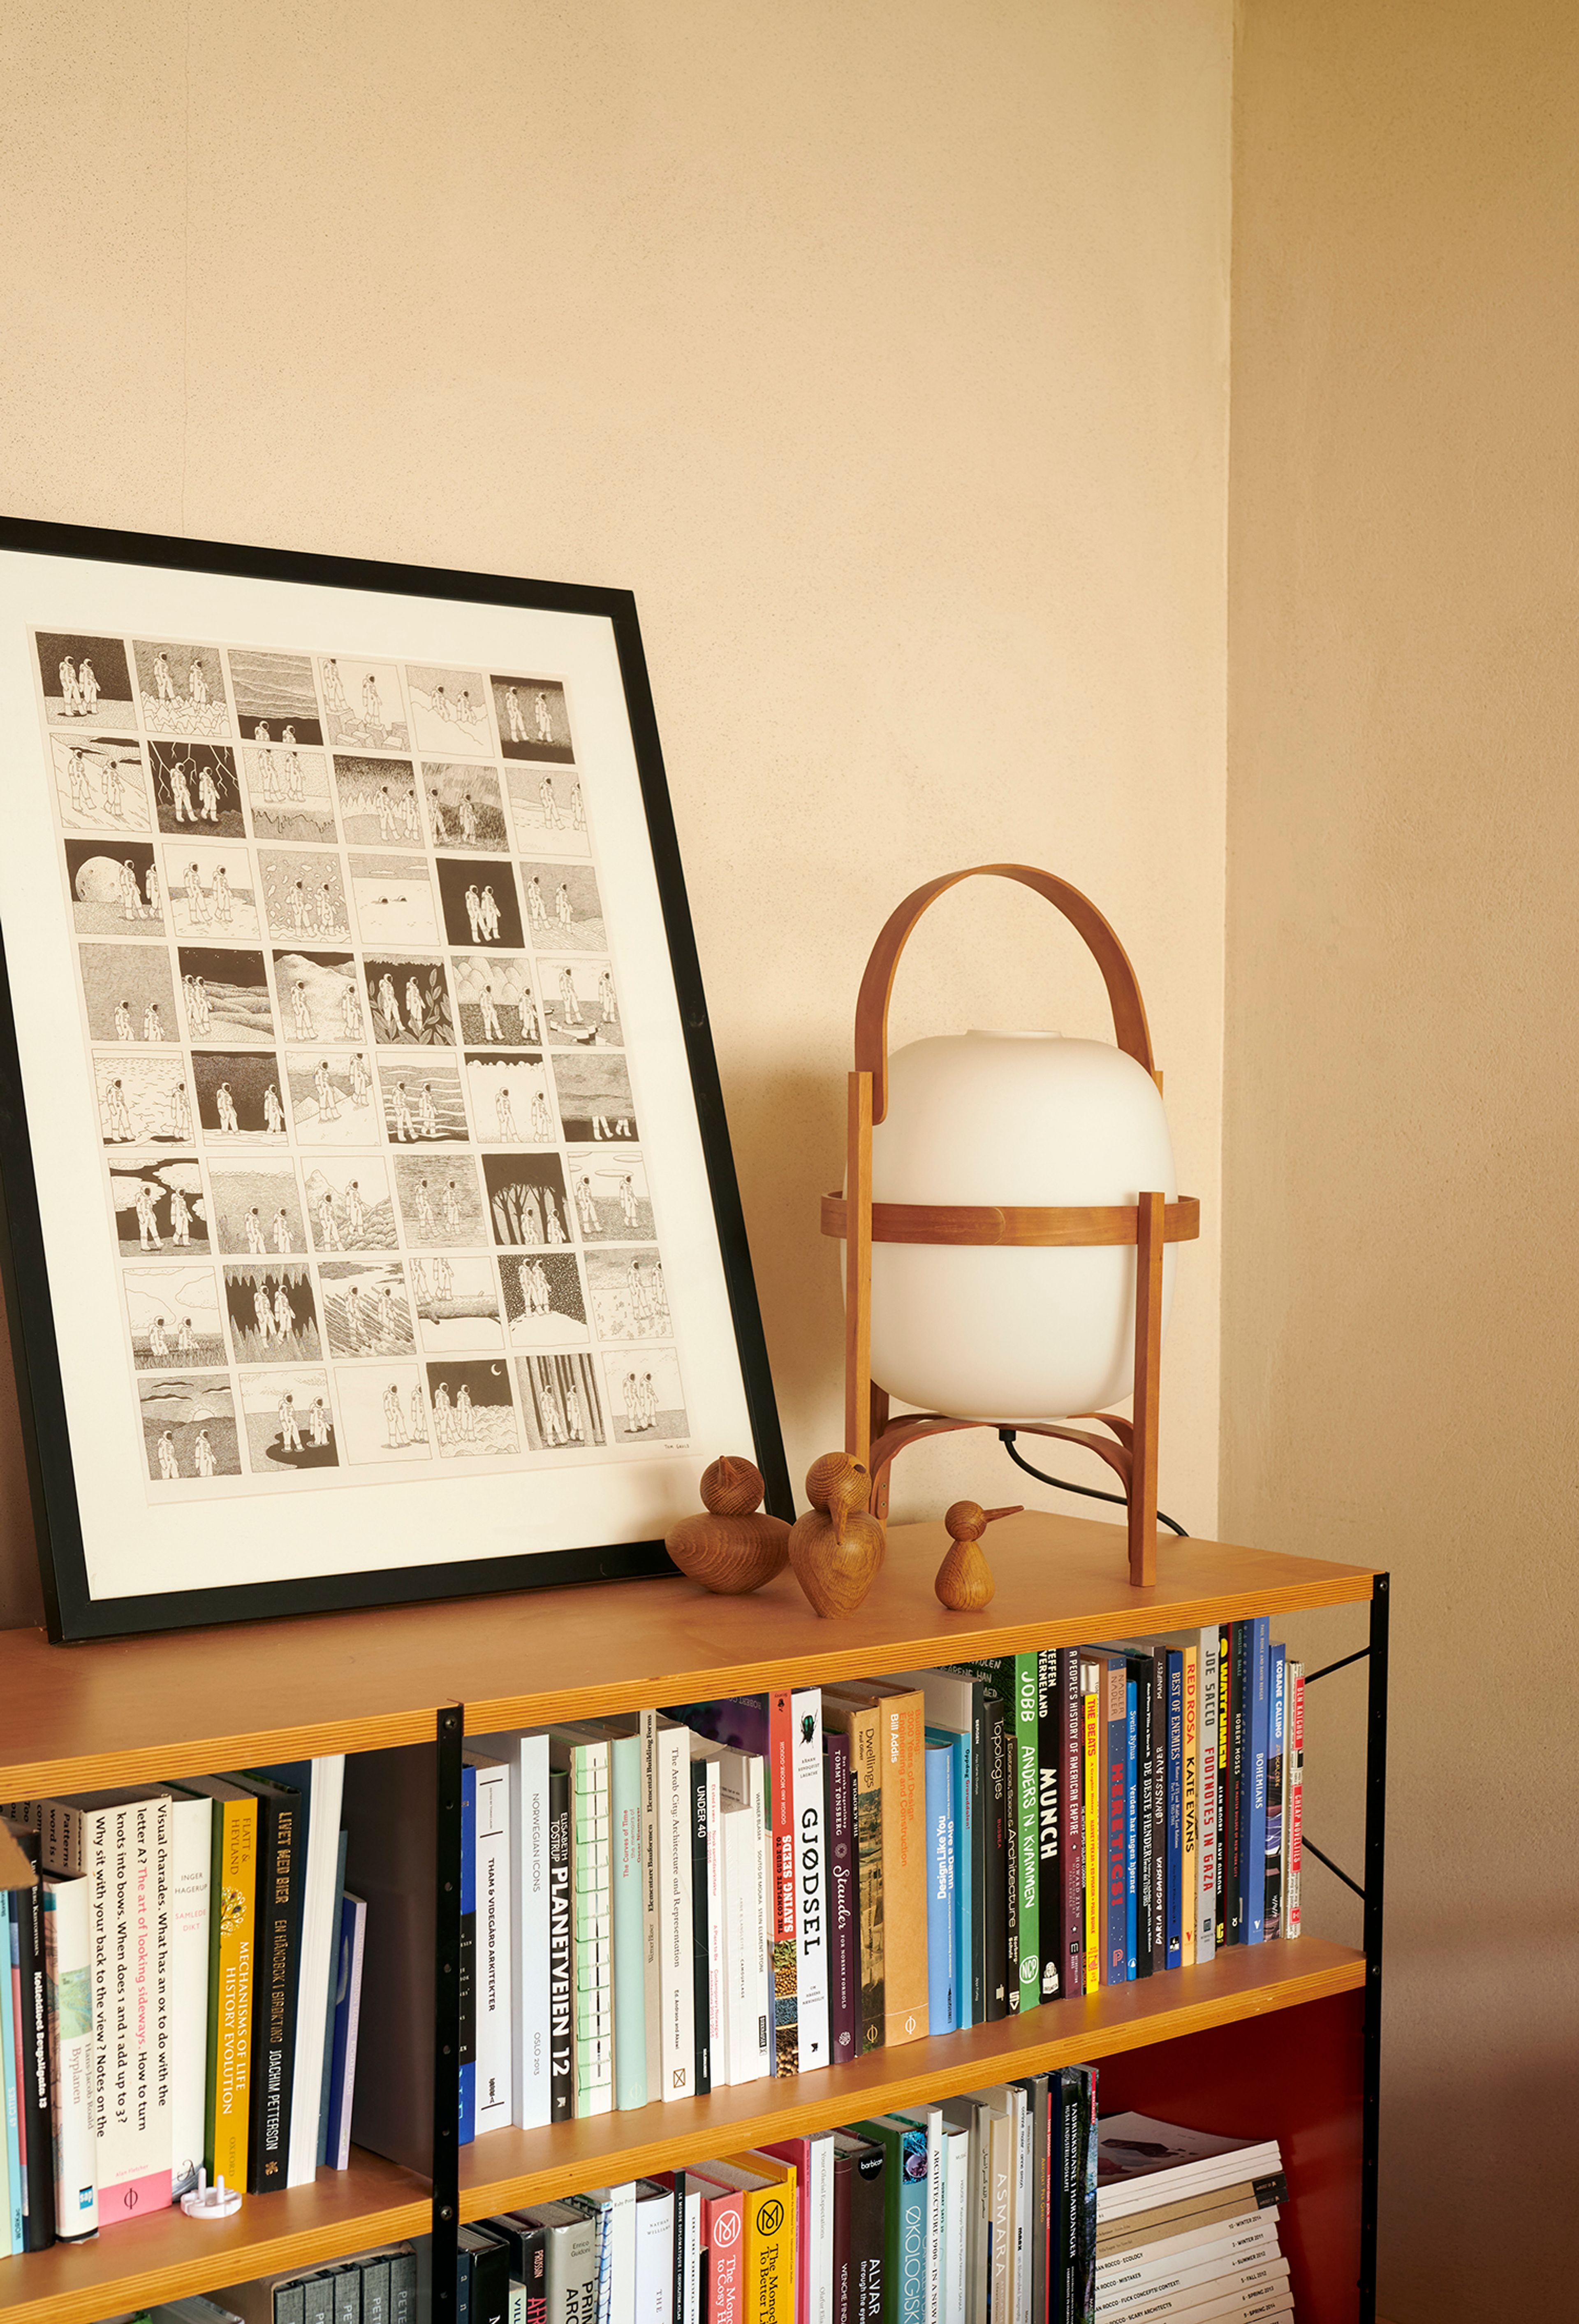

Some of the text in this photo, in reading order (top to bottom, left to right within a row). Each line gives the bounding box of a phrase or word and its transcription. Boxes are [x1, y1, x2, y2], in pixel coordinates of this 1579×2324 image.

[1039, 1650, 1047, 1718] VERNELAND
[1069, 1660, 1077, 1700] PEOPLE'S
[1205, 1650, 1215, 1727] JOE SACCO
[1172, 1672, 1181, 1760] BEST OF ENEMIES
[1187, 1700, 1195, 1744] ROSA
[865, 1728, 875, 1788] Dwellings
[991, 1717, 1005, 1799] Topologies
[1070, 1743, 1078, 1753] OF
[1144, 1762, 1152, 1776] DE
[908, 1771, 915, 1781] of
[1020, 1671, 1035, 1909] JOBB ANDERS N. KVAMMEN
[137, 1809, 146, 1844] letter
[670, 1794, 679, 1818] City:
[1040, 1769, 1057, 1860] MUNCH
[1204, 1747, 1214, 1892] FOOTNOTES IN GAZA
[116, 1813, 126, 1849] knots
[551, 1820, 559, 1862] TOSTRUP
[698, 1824, 706, 1838] 40
[1111, 1763, 1123, 1906] HERETICS!
[1143, 1814, 1152, 1858] FIENDER
[117, 1852, 126, 1879] into
[275, 1812, 292, 1903] LIVET MED BIER
[802, 1808, 820, 1955] GJØDSEL
[937, 1816, 947, 1899] Design Like You
[116, 1882, 126, 1919] bows.
[783, 1835, 793, 1932] SAVING SEEDS
[833, 1865, 851, 1930] Stauder
[117, 1922, 126, 1961] When
[138, 1917, 146, 1930] of
[672, 1898, 681, 1967] Representation
[93, 1816, 106, 2137] Why sit with your back to the Notes on the
[117, 1964, 127, 1994] does
[135, 1934, 148, 1983] looking
[157, 1804, 168, 2106] Visual charades. What has an ox to do with the
[551, 1867, 570, 2077] PLANETVEIEN 12
[117, 2006, 126, 2031] and
[136, 1986, 147, 2049] sideways.
[222, 1967, 236, 2114] HISTORY EVOLUTION
[236, 1942, 249, 2091] MECHANISMS OF LIFE
[68, 2048, 81, 2104] Byplanen
[116, 2071, 125, 2088] up
[117, 2045, 127, 2067] add
[138, 2052, 147, 2082] How
[117, 2092, 125, 2106] to
[139, 2085, 146, 2098] to
[266, 2050, 282, 2150] JOACHIM PETTERSON
[995, 2173, 1007, 2276] ASMARA
[726, 2254, 735, 2282] The
[760, 2246, 769, 2306] To Better
[769, 2244, 778, 2271] The
[1123, 2253, 1143, 2263] ECOLOGY
[716, 2259, 726, 2306] to Cosy
[868, 2259, 880, 2316] ALVAR
